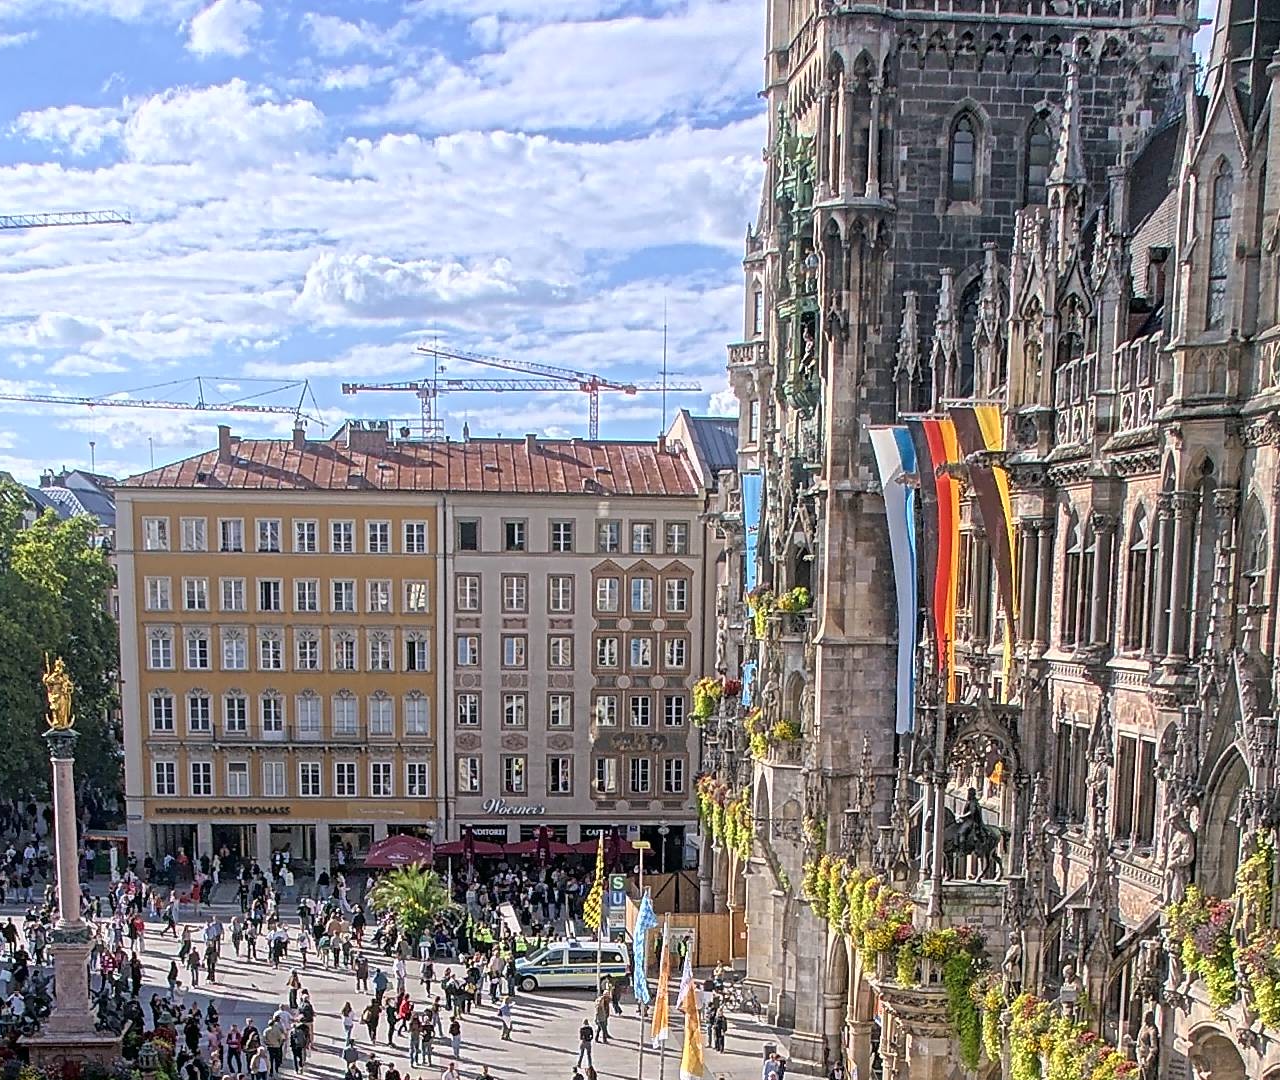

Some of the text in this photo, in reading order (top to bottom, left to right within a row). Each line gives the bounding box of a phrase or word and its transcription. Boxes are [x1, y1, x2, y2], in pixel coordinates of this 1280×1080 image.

[210, 807, 235, 815] CARL
[239, 807, 291, 815] THOMASS
[613, 877, 624, 889] S
[613, 892, 623, 904] U
